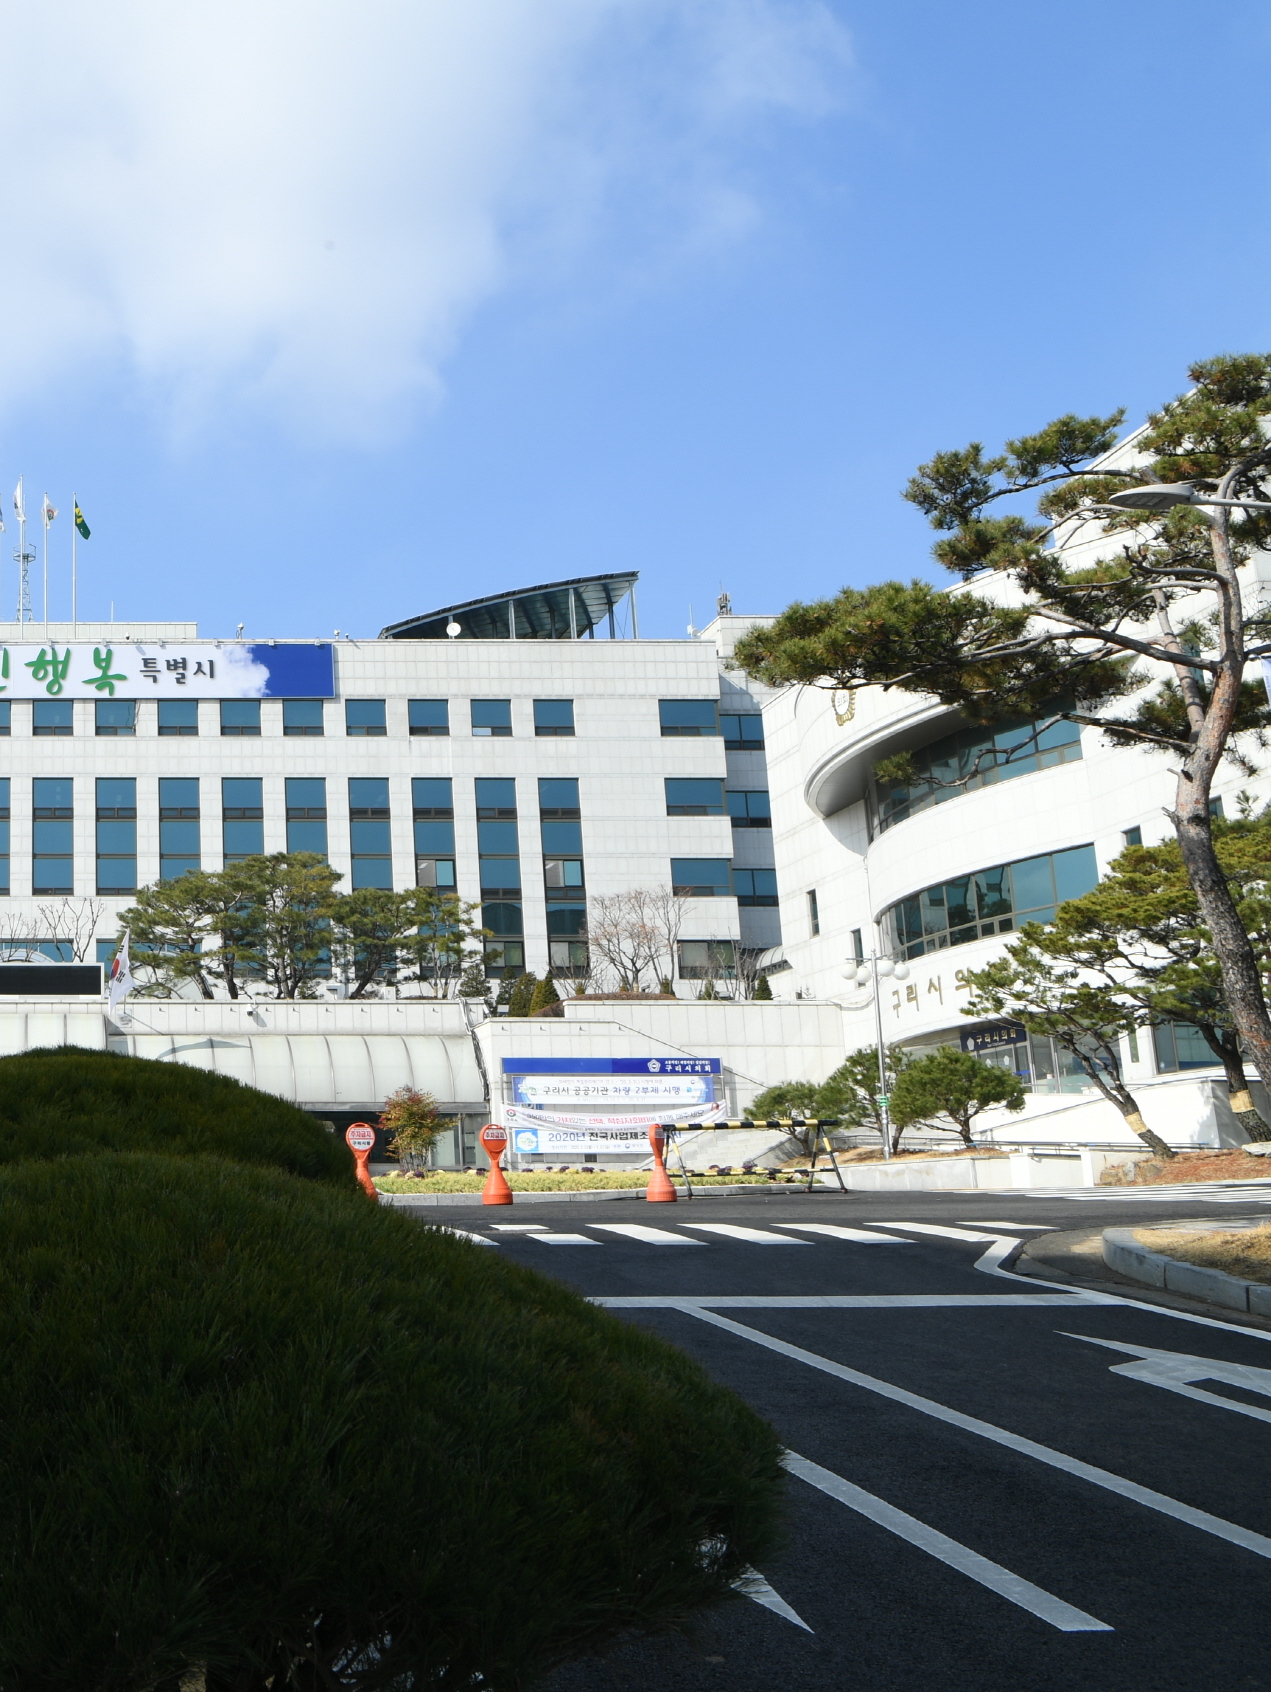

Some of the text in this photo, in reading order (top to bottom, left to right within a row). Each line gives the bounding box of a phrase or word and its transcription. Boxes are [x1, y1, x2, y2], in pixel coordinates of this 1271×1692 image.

[139, 656, 215, 685] 특별시
[976, 1028, 1016, 1046] 구리시의회
[665, 1064, 712, 1073] 구리시의회
[543, 1086, 570, 1096] 구리시
[573, 1086, 608, 1096] 공공기관
[613, 1086, 631, 1096] 차량
[635, 1086, 659, 1095] 2부제
[663, 1086, 681, 1095] 시행
[351, 1130, 372, 1138] 주차금지
[548, 1131, 586, 1142] 2020년
